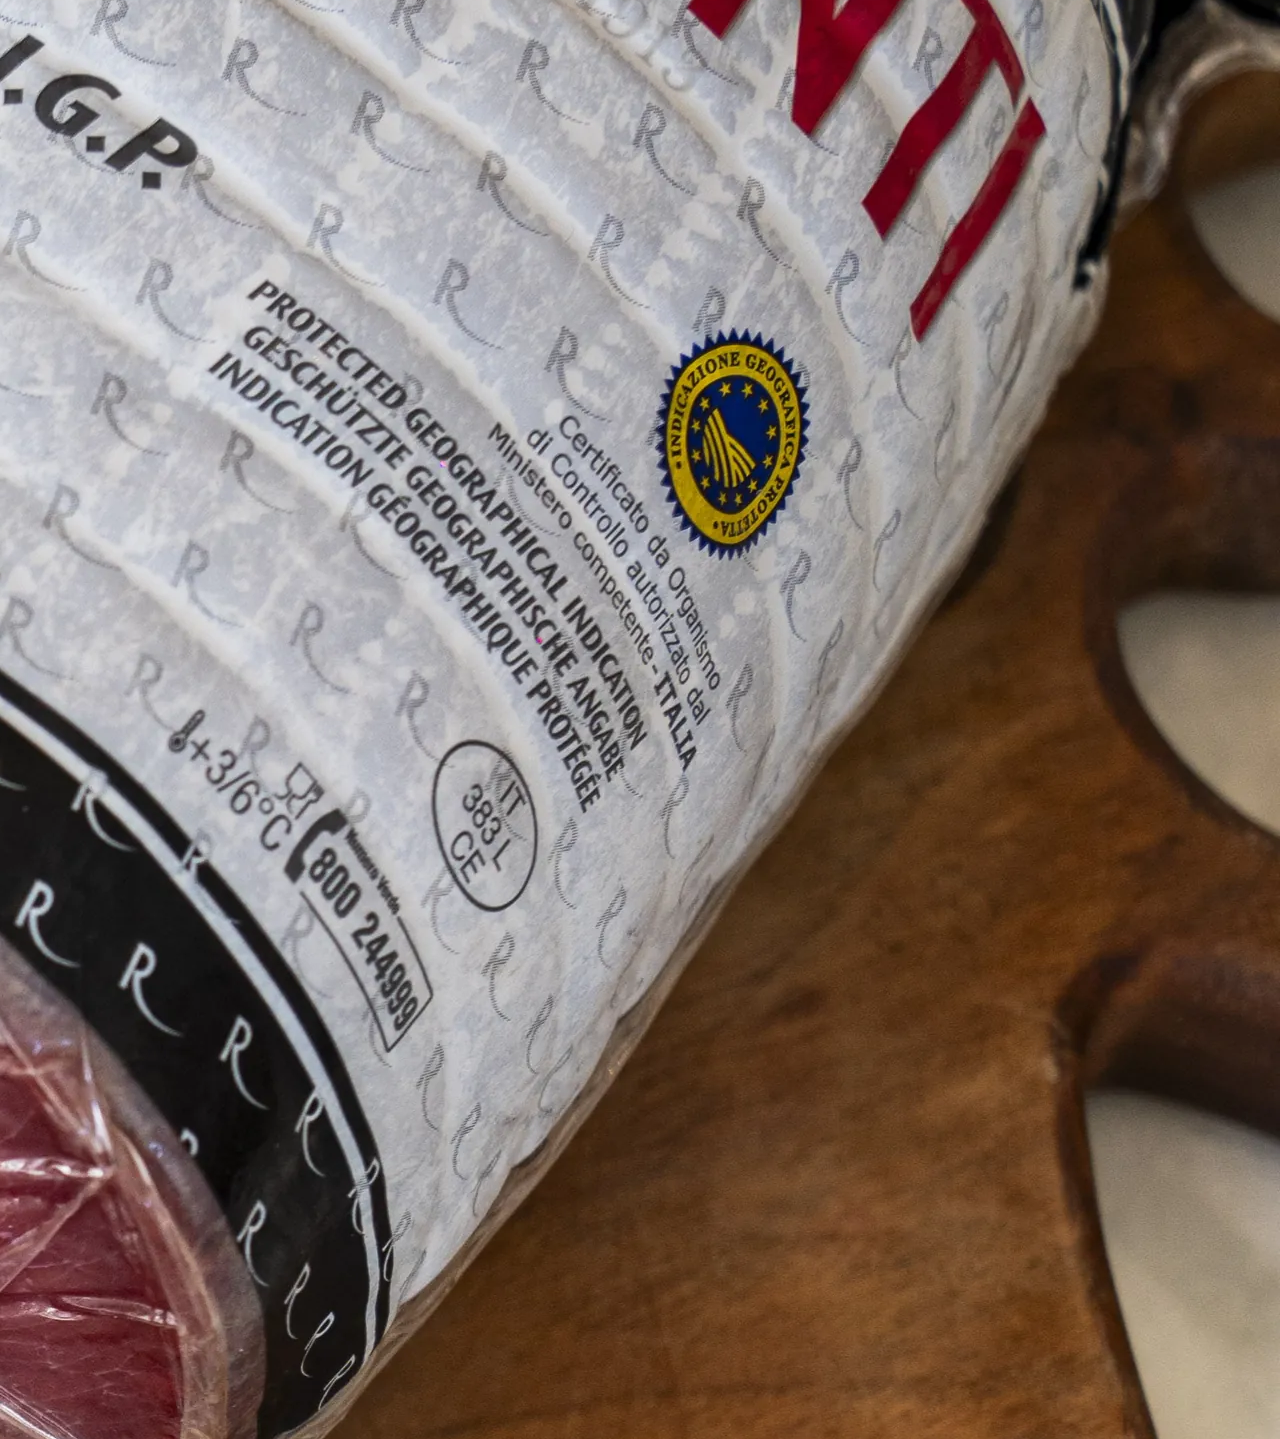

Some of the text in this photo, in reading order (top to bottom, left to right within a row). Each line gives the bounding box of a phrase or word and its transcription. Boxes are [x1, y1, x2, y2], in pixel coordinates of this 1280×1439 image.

[242, 324, 625, 783] GESCHÜTZTE GEOGRAPHISCHE ANGABE
[246, 280, 648, 750] PROTECTED GEOGRAPHICAL INDICATION
[559, 415, 722, 691] Certificato da Organismo
[671, 351, 796, 537] INDICAZIONE GEOGRAFICA PROTETTA
[208, 352, 602, 814] INDICATION GÉOGRAPHIQUE PROTÉGÉE
[488, 423, 574, 530] Ministero
[653, 675, 699, 772] ITALIA
[527, 429, 710, 728] di Controllo autorizzato dal
[189, 739, 293, 852] +3/6°C
[450, 830, 486, 885] CE
[461, 784, 514, 873] 383 L
[499, 783, 526, 818] IT
[308, 849, 421, 1032] 800 244999
